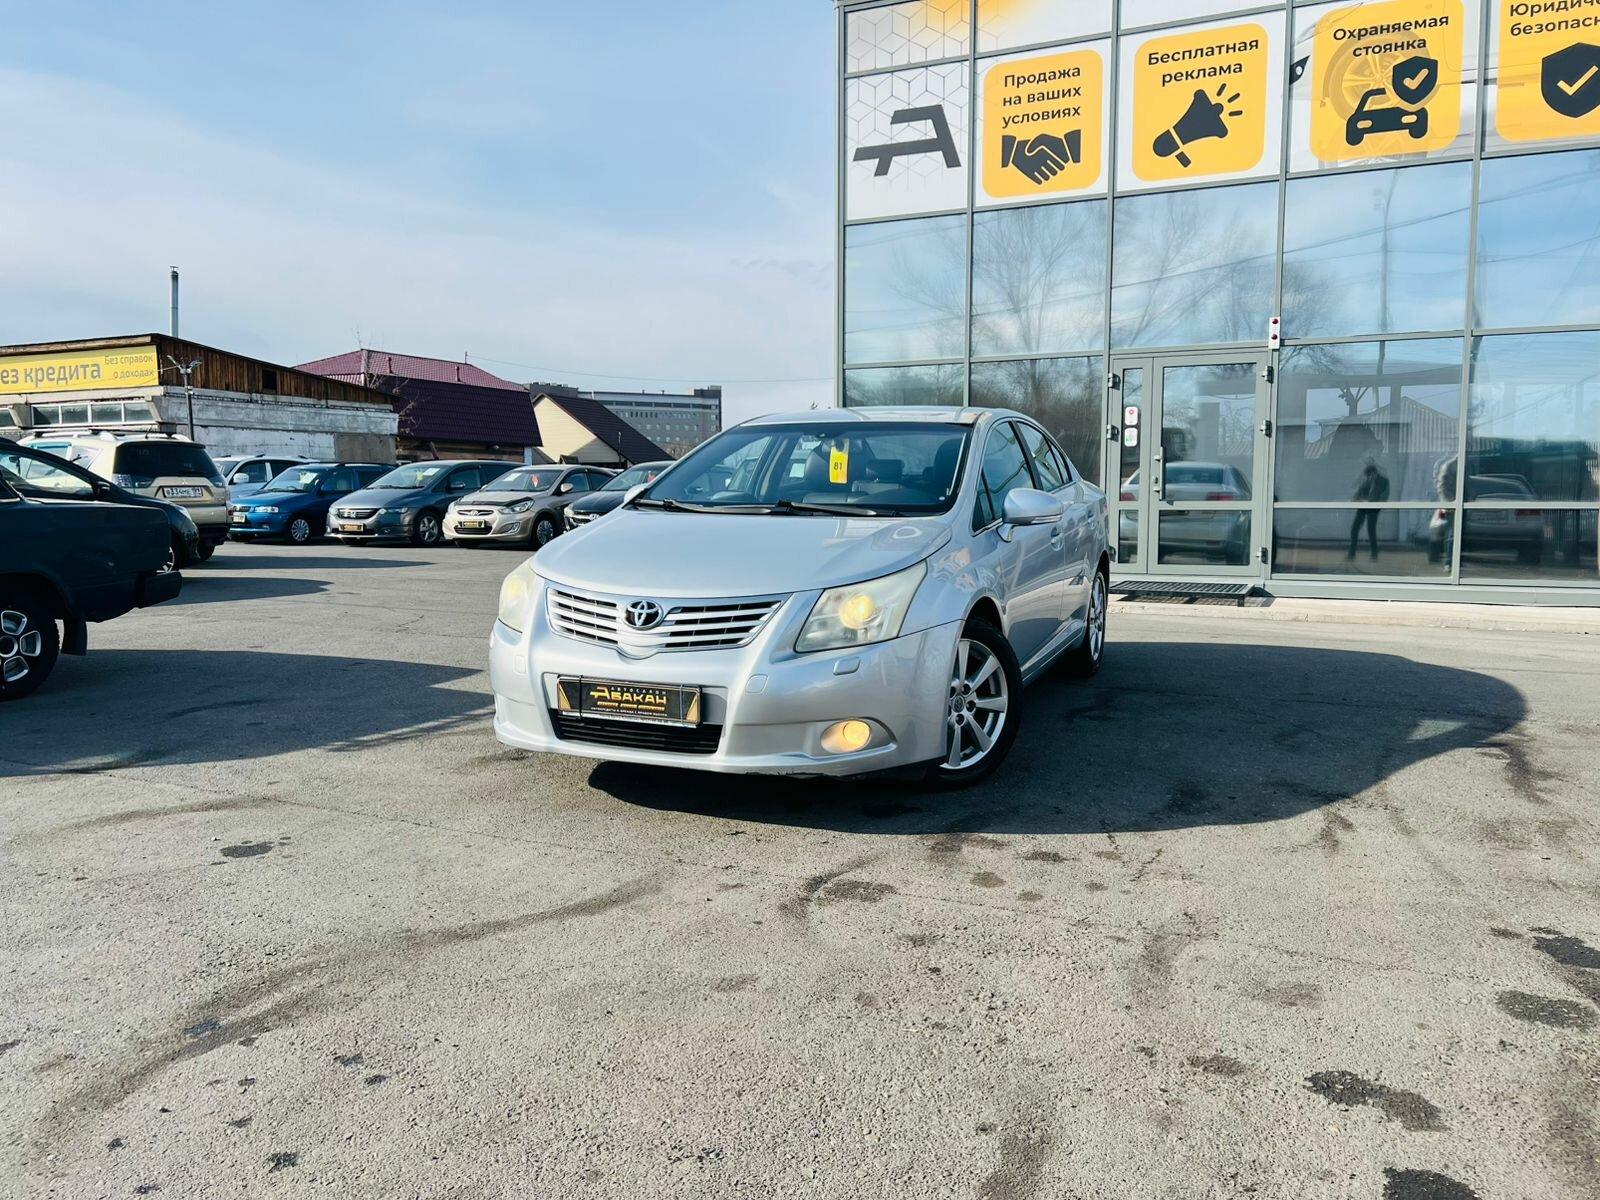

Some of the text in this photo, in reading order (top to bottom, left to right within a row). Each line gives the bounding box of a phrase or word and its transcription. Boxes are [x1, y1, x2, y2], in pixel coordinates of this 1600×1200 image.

[1333, 15, 1449, 41] Охраняемая
[1148, 39, 1259, 65] Бесплатная
[1352, 38, 1427, 57] стоянка
[1004, 65, 1081, 88] Продажа
[1161, 62, 1243, 87] реклама
[1002, 86, 1081, 107] на ваших
[1002, 105, 1081, 129] условиях
[104, 354, 154, 366] Без справок
[24, 363, 101, 388] кредита
[119, 369, 155, 380] доходах
